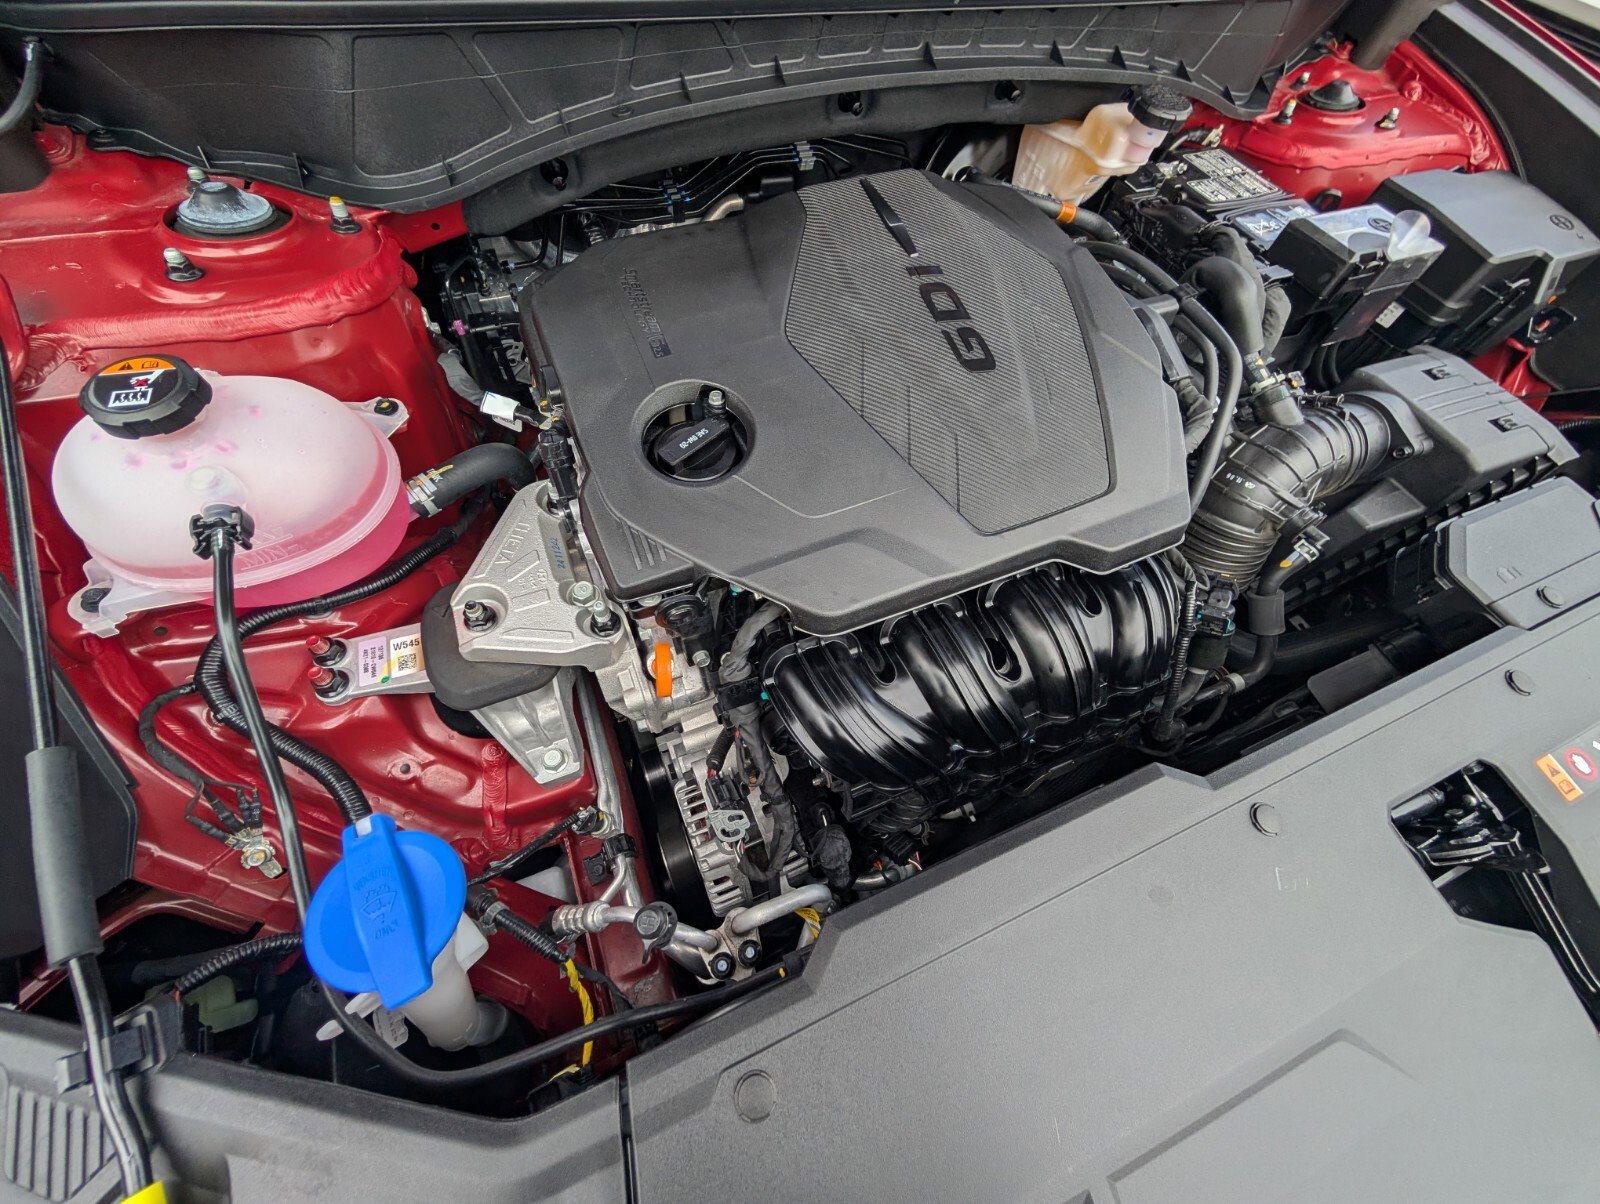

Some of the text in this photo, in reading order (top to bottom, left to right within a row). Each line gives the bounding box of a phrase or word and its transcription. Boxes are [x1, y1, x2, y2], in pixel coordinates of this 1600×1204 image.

[905, 265, 997, 374] GDI
[695, 427, 709, 439] SAE
[494, 522, 530, 564] THETA
[393, 637, 421, 651] W545
